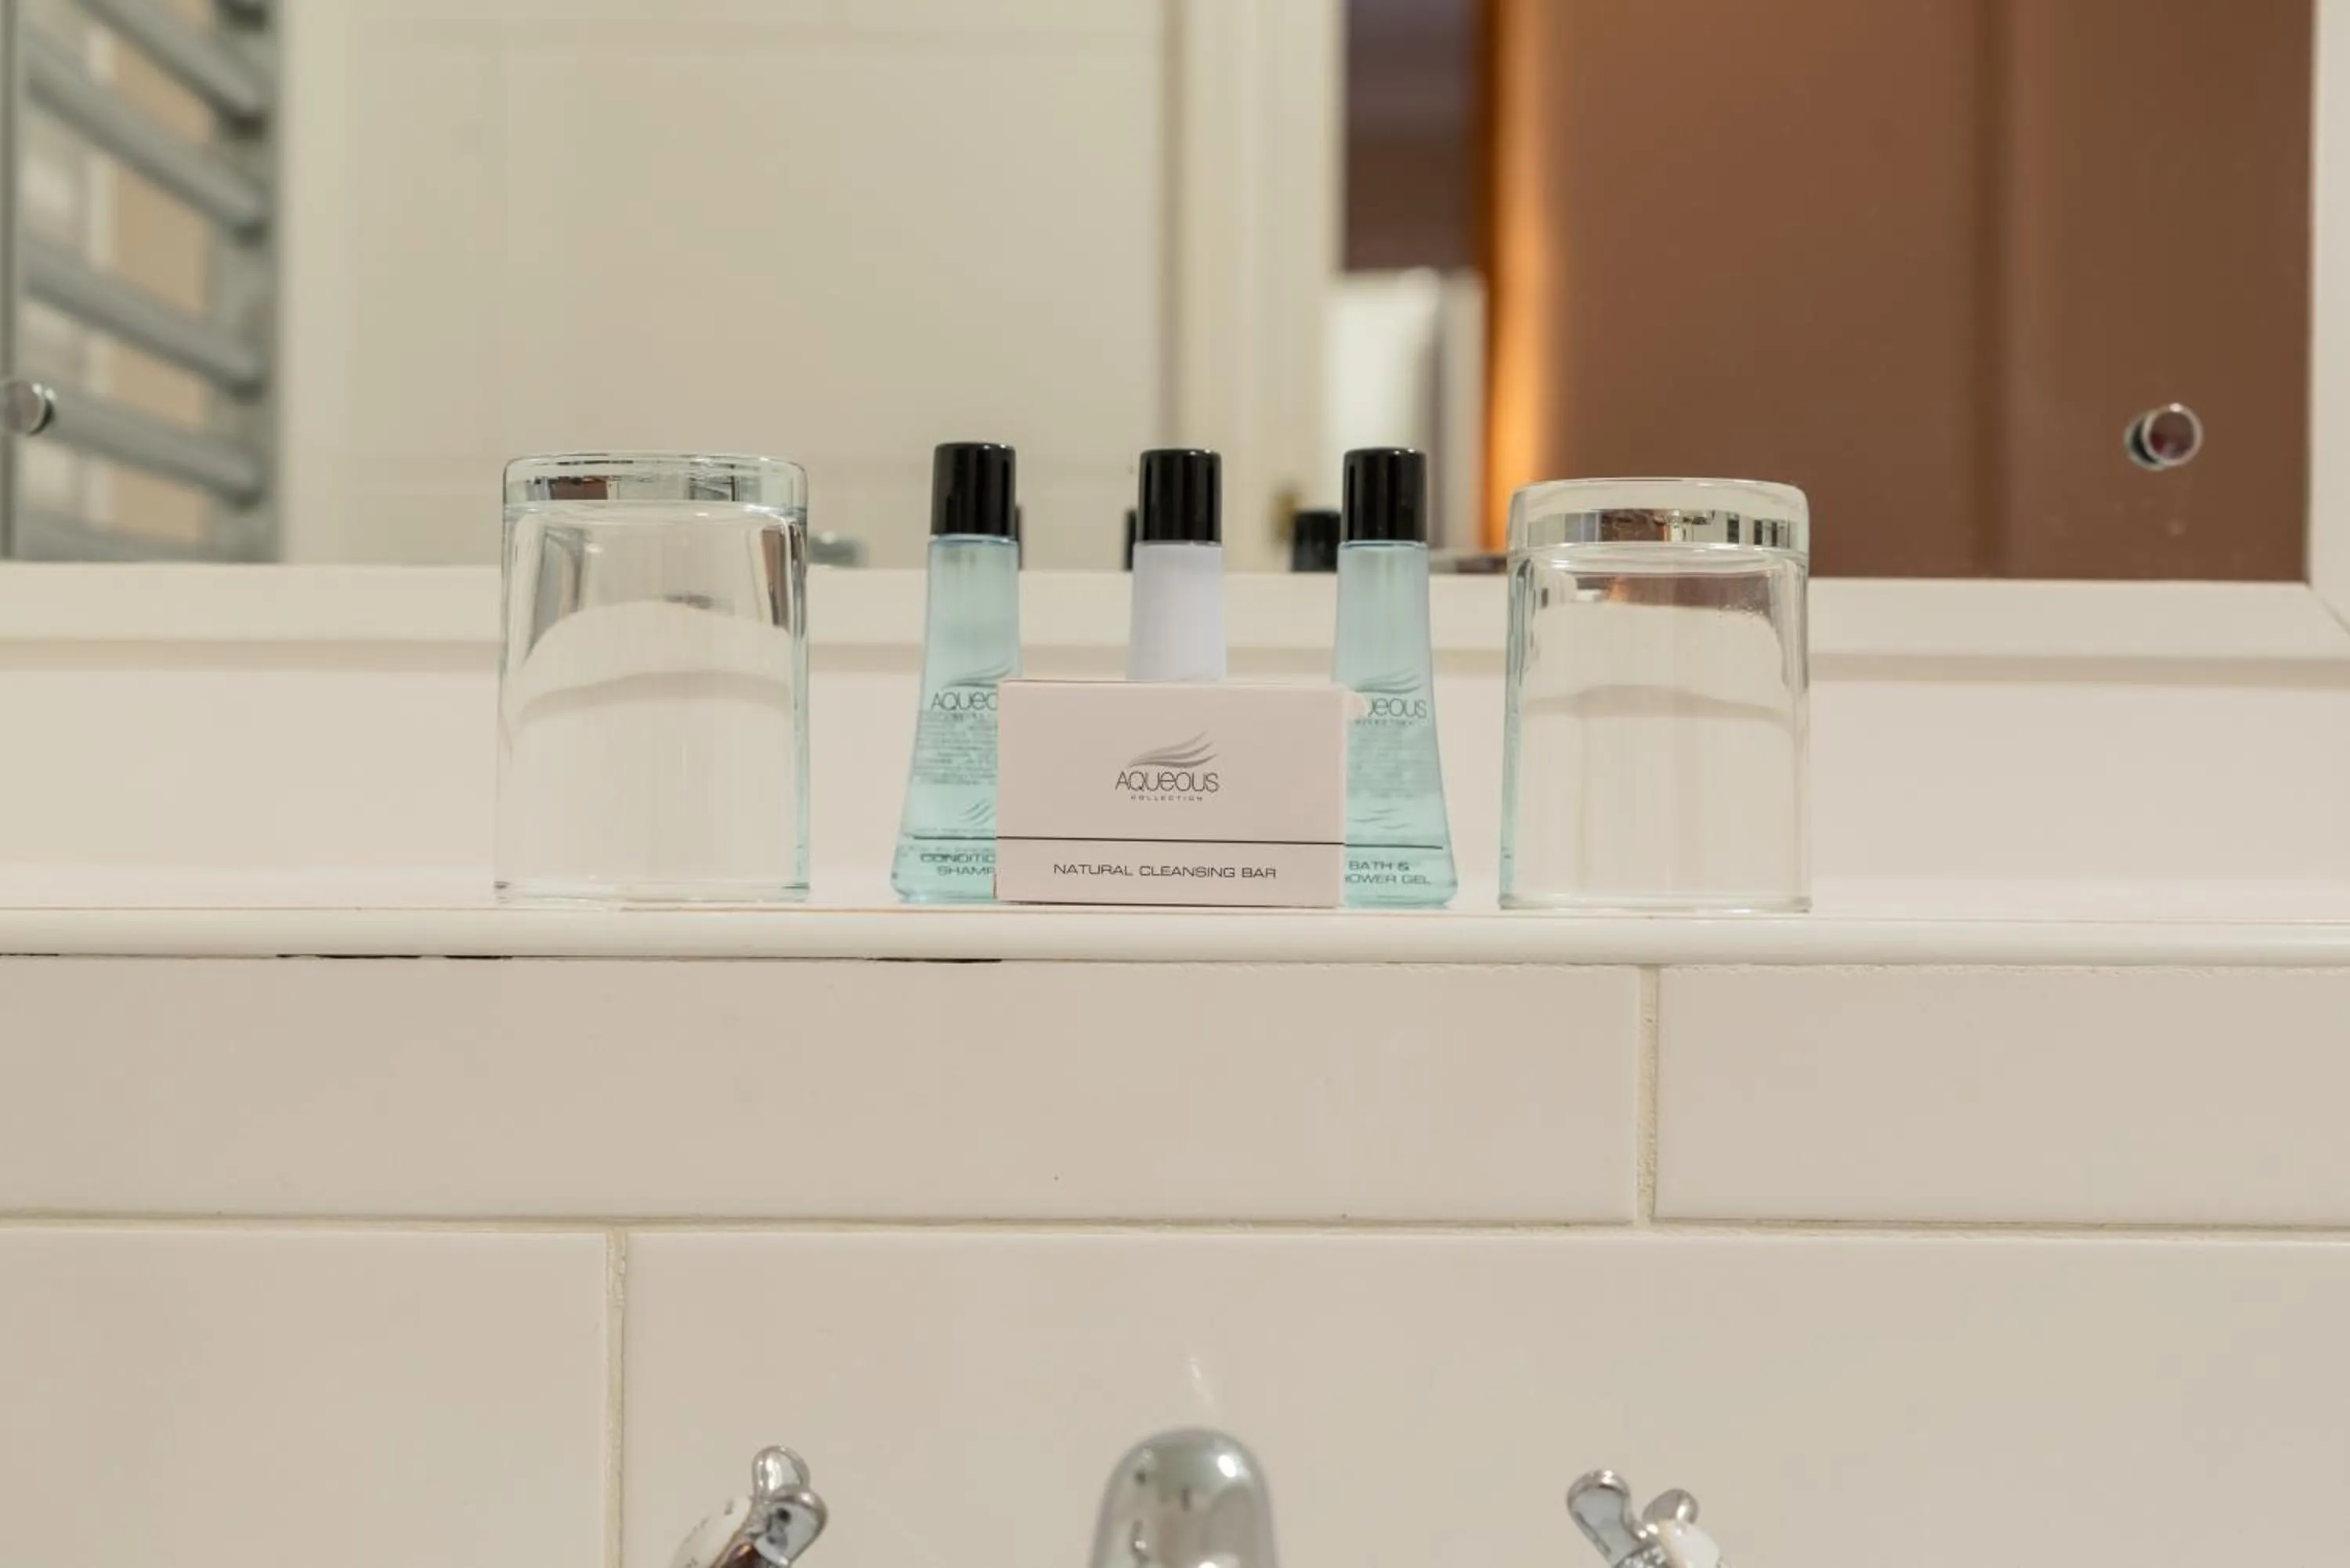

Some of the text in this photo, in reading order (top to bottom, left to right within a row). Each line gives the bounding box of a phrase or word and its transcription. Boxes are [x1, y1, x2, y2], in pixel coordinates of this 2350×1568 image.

[920, 853, 996, 863] CONDITIO
[937, 865, 996, 876] SHAMP
[1054, 864, 1277, 879] NATURAL CLEANSING BAR
[1348, 861, 1393, 871] BATH
[1344, 873, 1430, 885] OWER GEL
